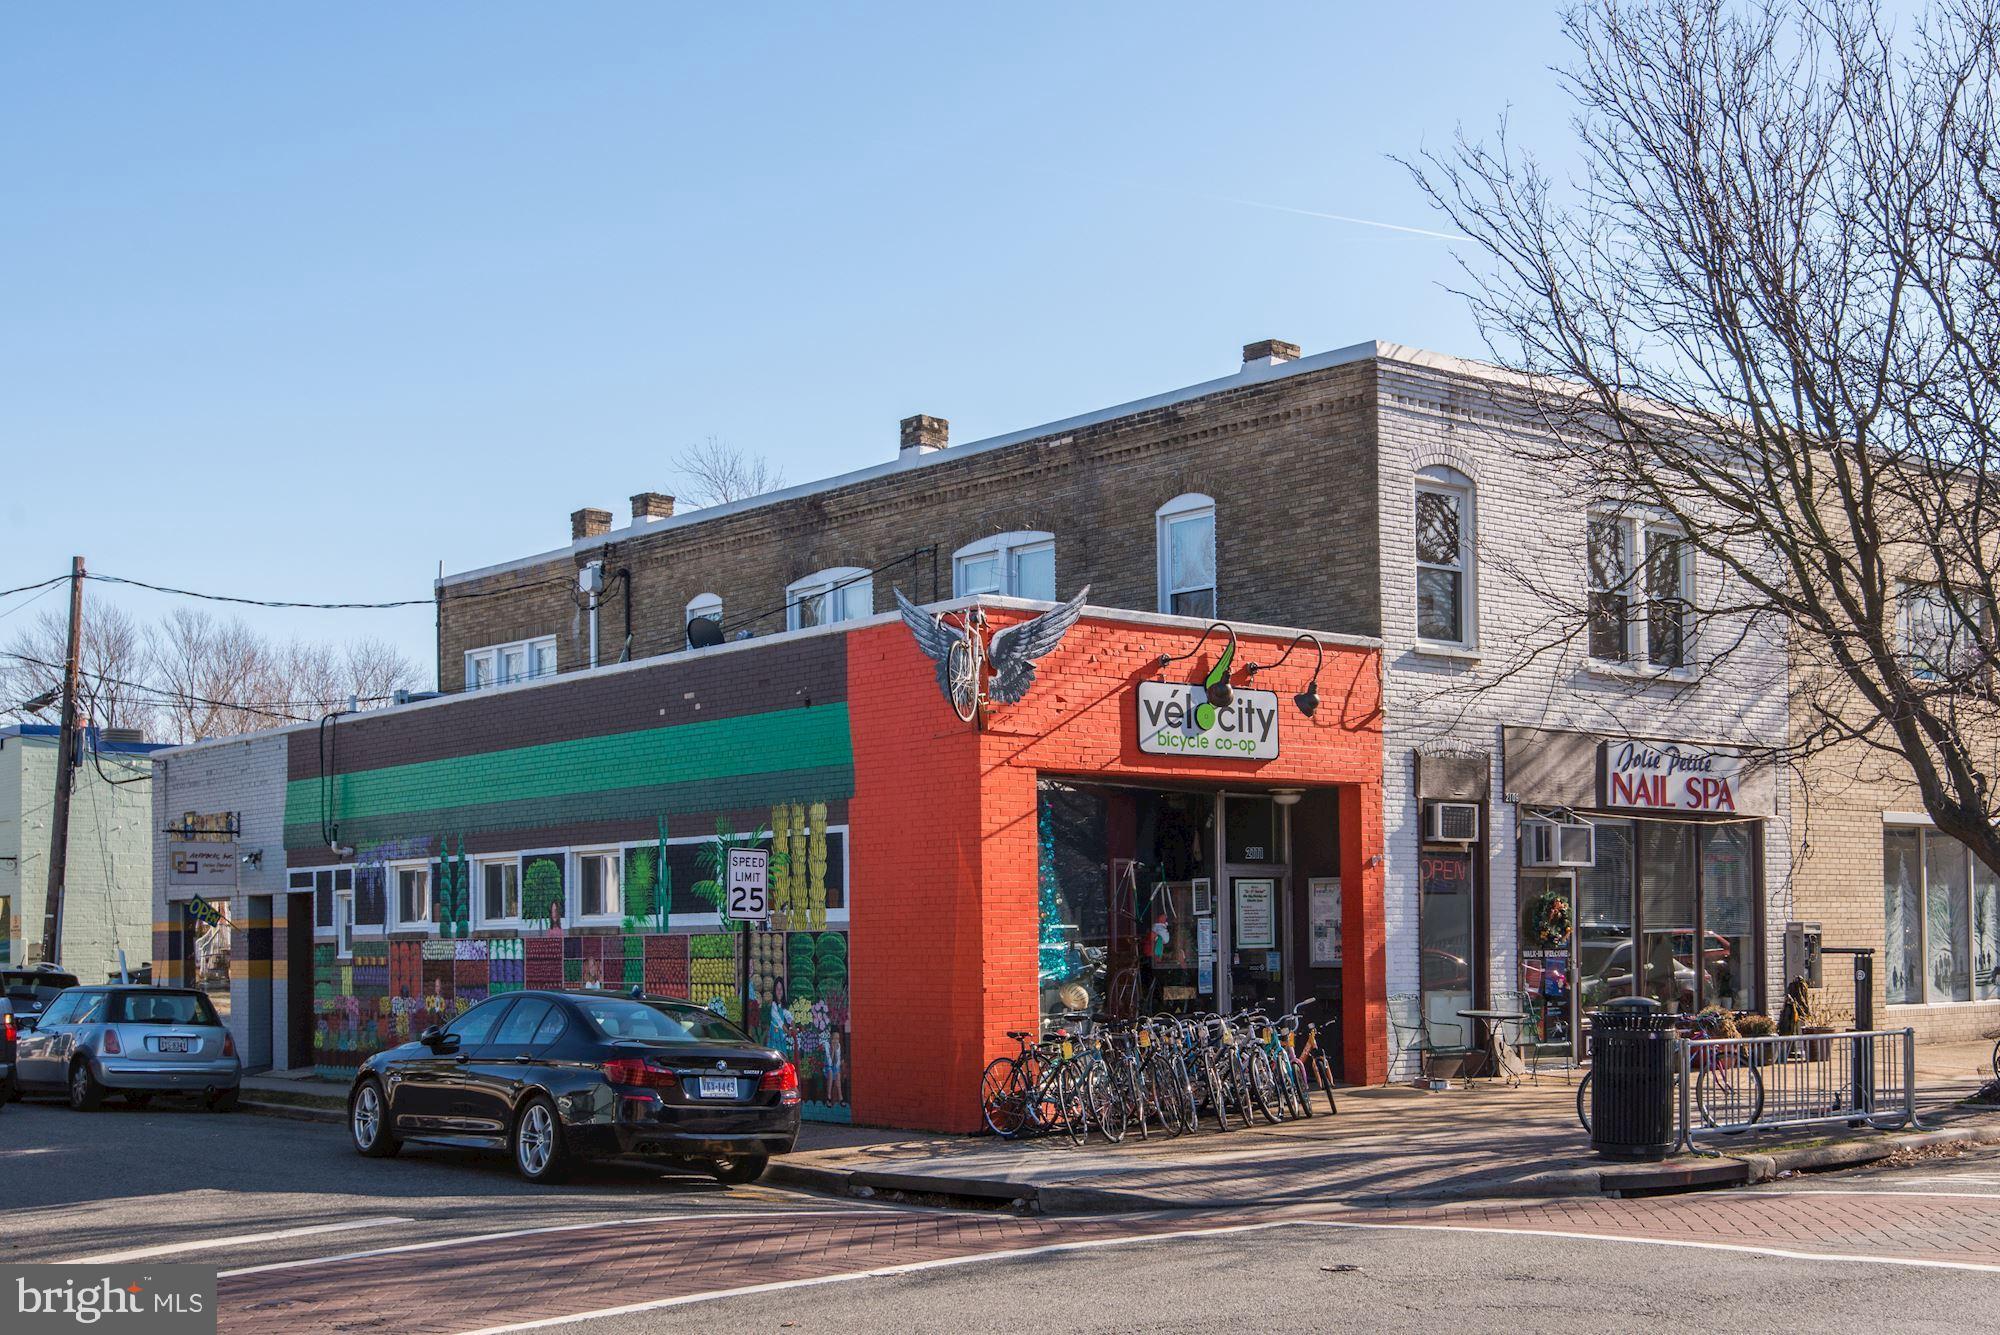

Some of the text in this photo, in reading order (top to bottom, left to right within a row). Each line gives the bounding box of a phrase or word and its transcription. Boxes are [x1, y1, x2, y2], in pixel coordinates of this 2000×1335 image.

[1143, 689, 1276, 743] vélocity
[1157, 730, 1257, 755] bicycle co-op
[1617, 743, 1712, 776] Jolie Petite
[1612, 772, 1736, 811] NAIL SPA
[732, 856, 765, 868] SPEED
[1421, 859, 1465, 880] OPEN
[735, 872, 760, 882] LIMIT
[189, 898, 220, 924] OPEN
[731, 886, 764, 912] 25
